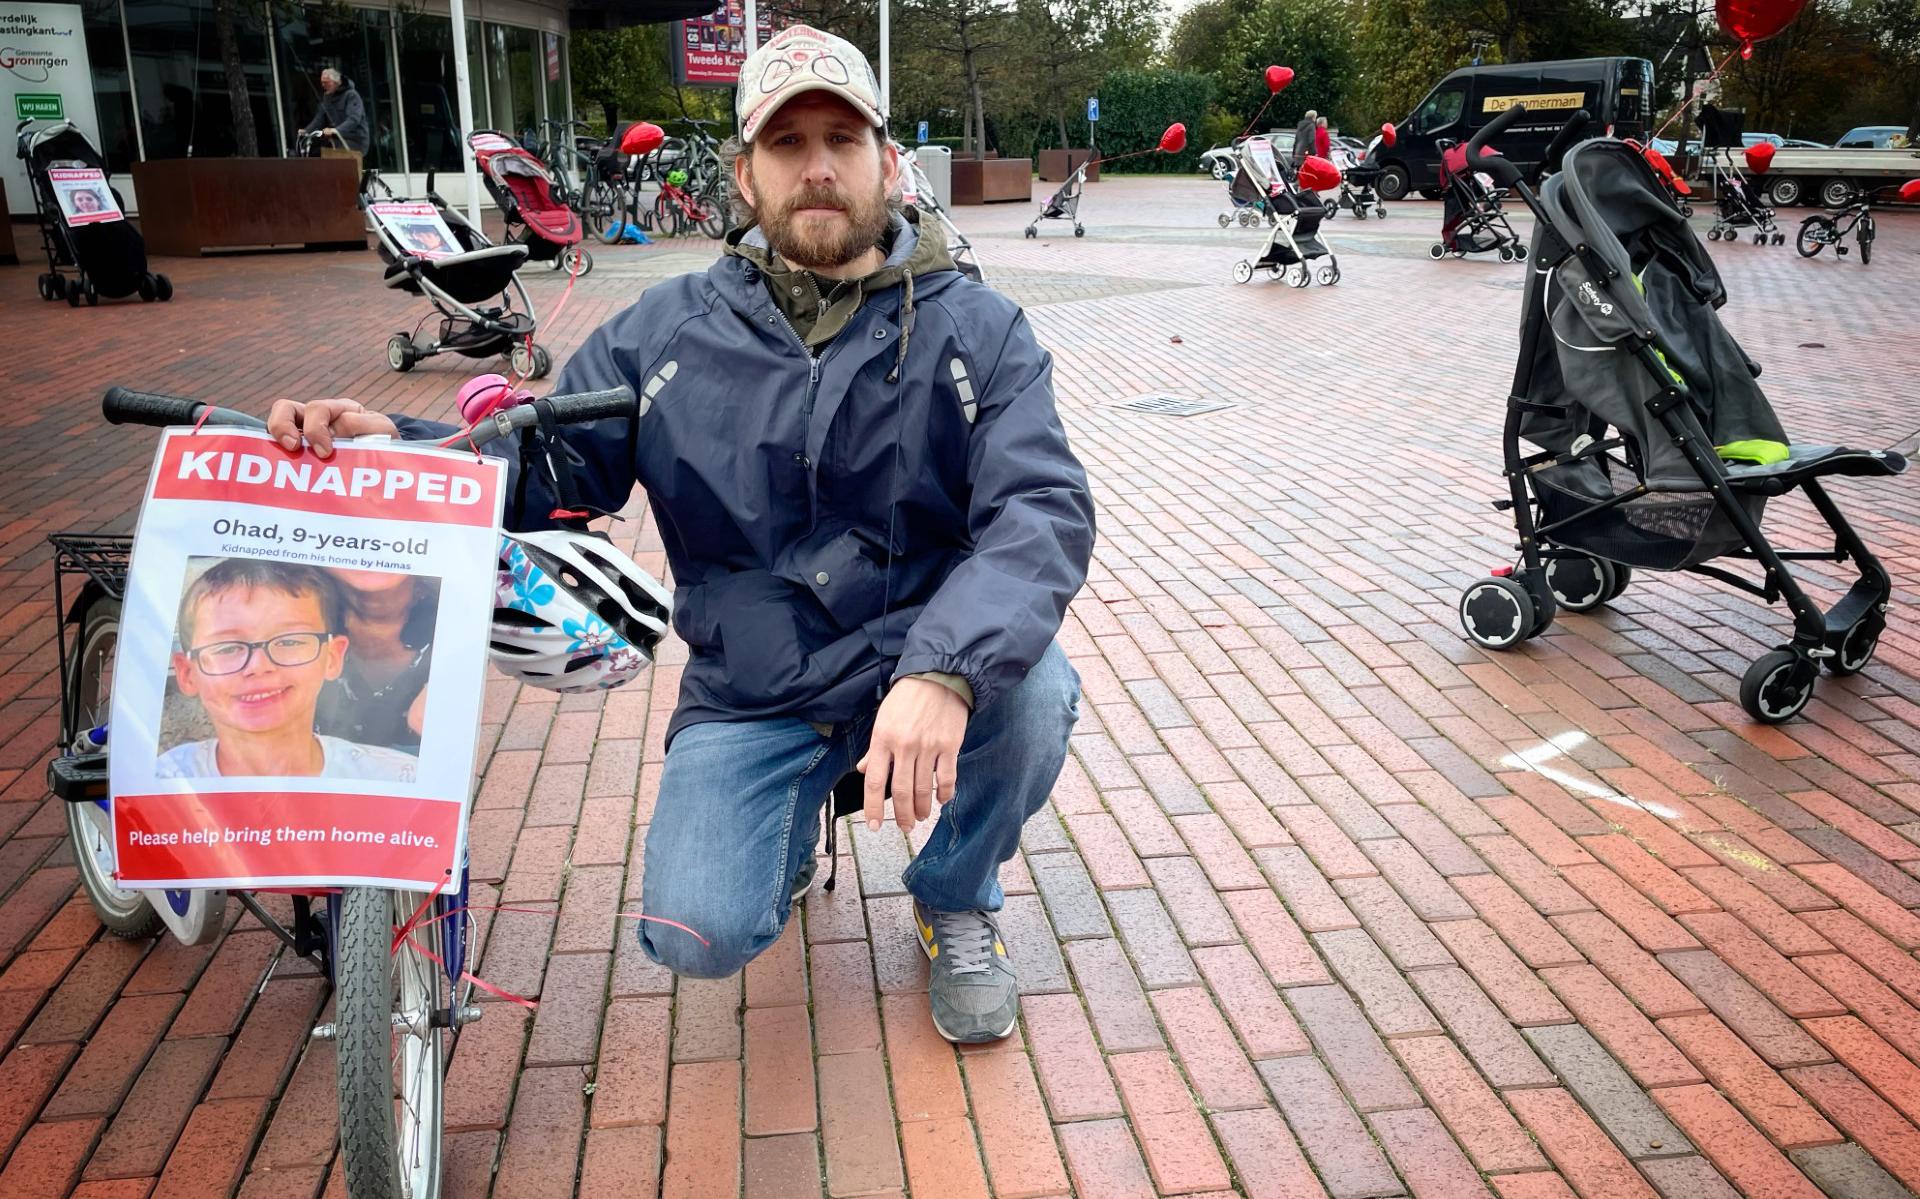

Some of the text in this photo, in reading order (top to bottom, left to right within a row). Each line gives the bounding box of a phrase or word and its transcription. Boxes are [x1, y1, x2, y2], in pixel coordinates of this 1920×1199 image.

[0, 14, 37, 24] rdelijk
[0, 51, 68, 71] Groningen
[686, 52, 723, 65] Tweede
[35, 103, 58, 112] HAREN
[1091, 101, 1097, 109] P
[1491, 96, 1577, 110] De Timmerman
[1582, 281, 1602, 306] Safety
[177, 451, 483, 505] KIDNAPPED
[213, 519, 429, 556] Ohad, 9-years-old
[221, 543, 412, 571] Kidnapped from his home by Hamas
[129, 826, 440, 849] Please help bring them home alive.
